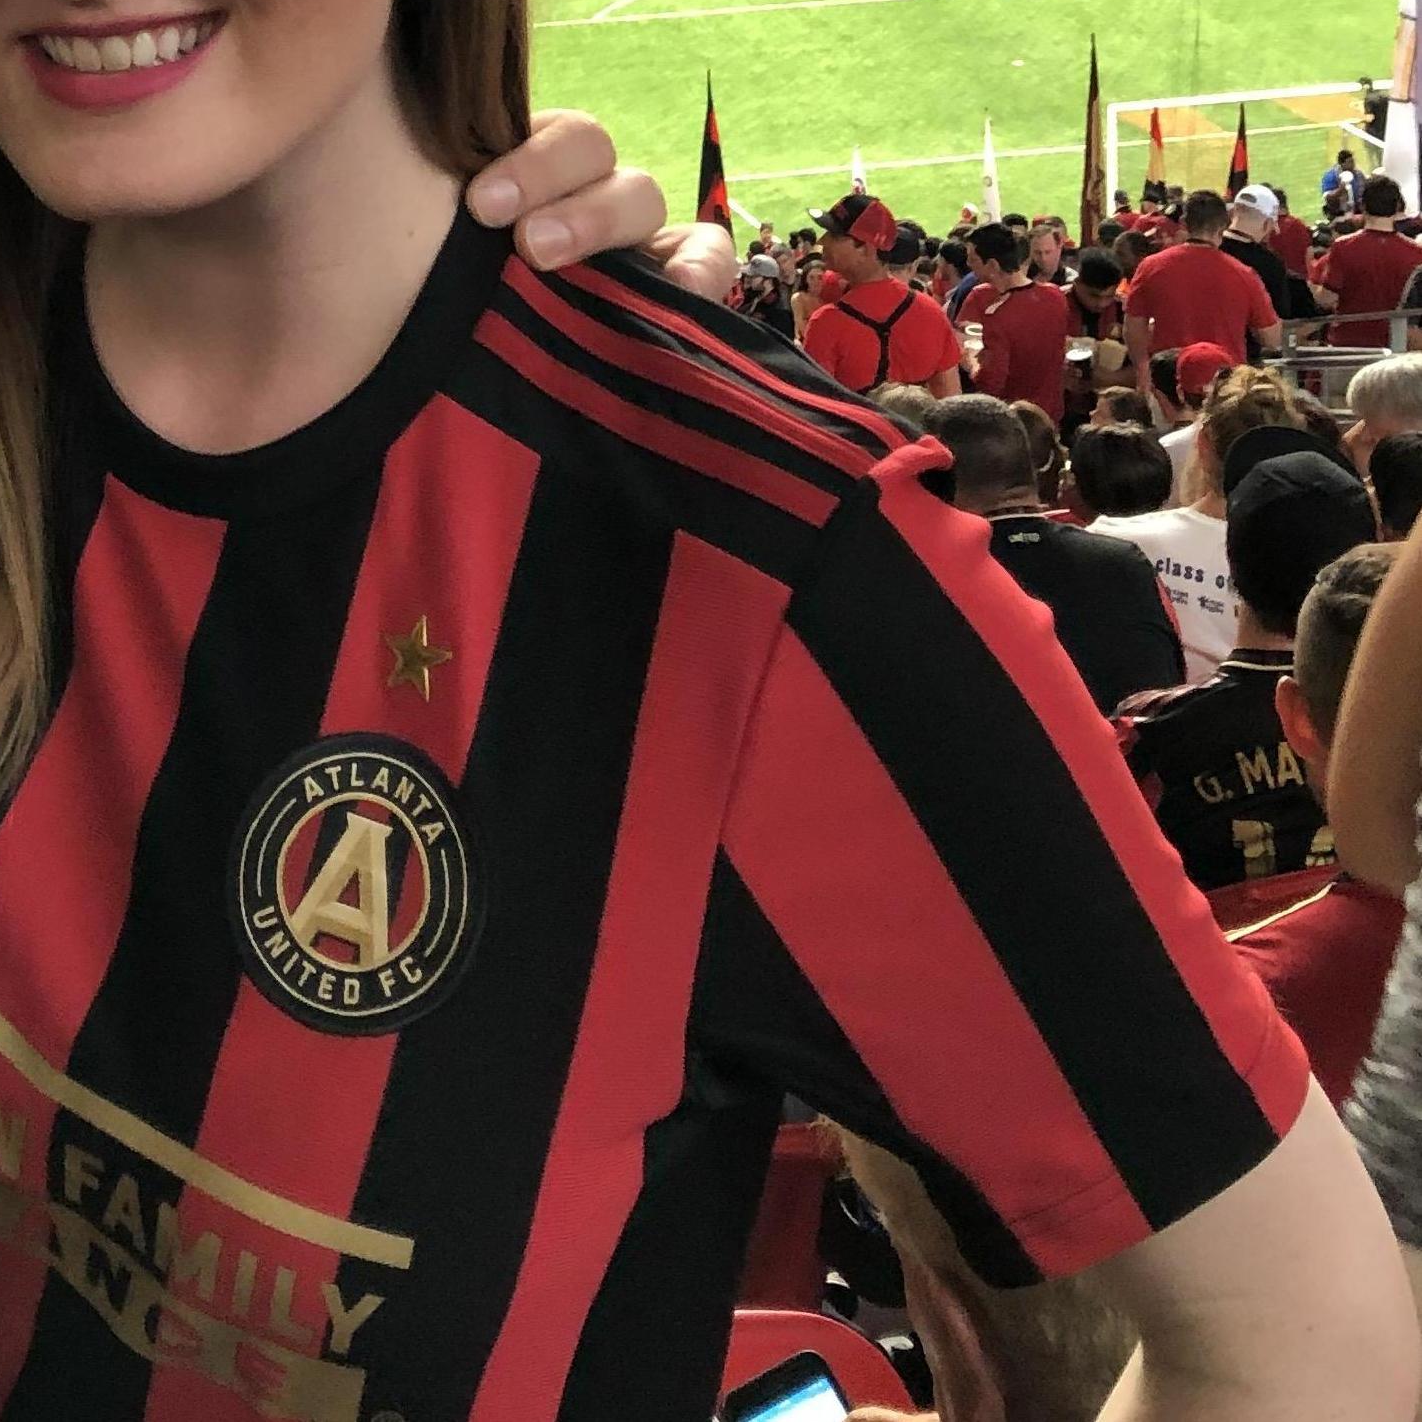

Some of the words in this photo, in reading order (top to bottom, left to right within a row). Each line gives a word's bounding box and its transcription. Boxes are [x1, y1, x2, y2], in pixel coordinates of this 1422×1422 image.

[1155, 558, 1204, 583] class
[303, 762, 446, 845] ATLANTA
[290, 811, 394, 969] A
[252, 905, 361, 1006] UNITED
[378, 956, 423, 998] FC
[63, 1143, 386, 1354] FAMILY
